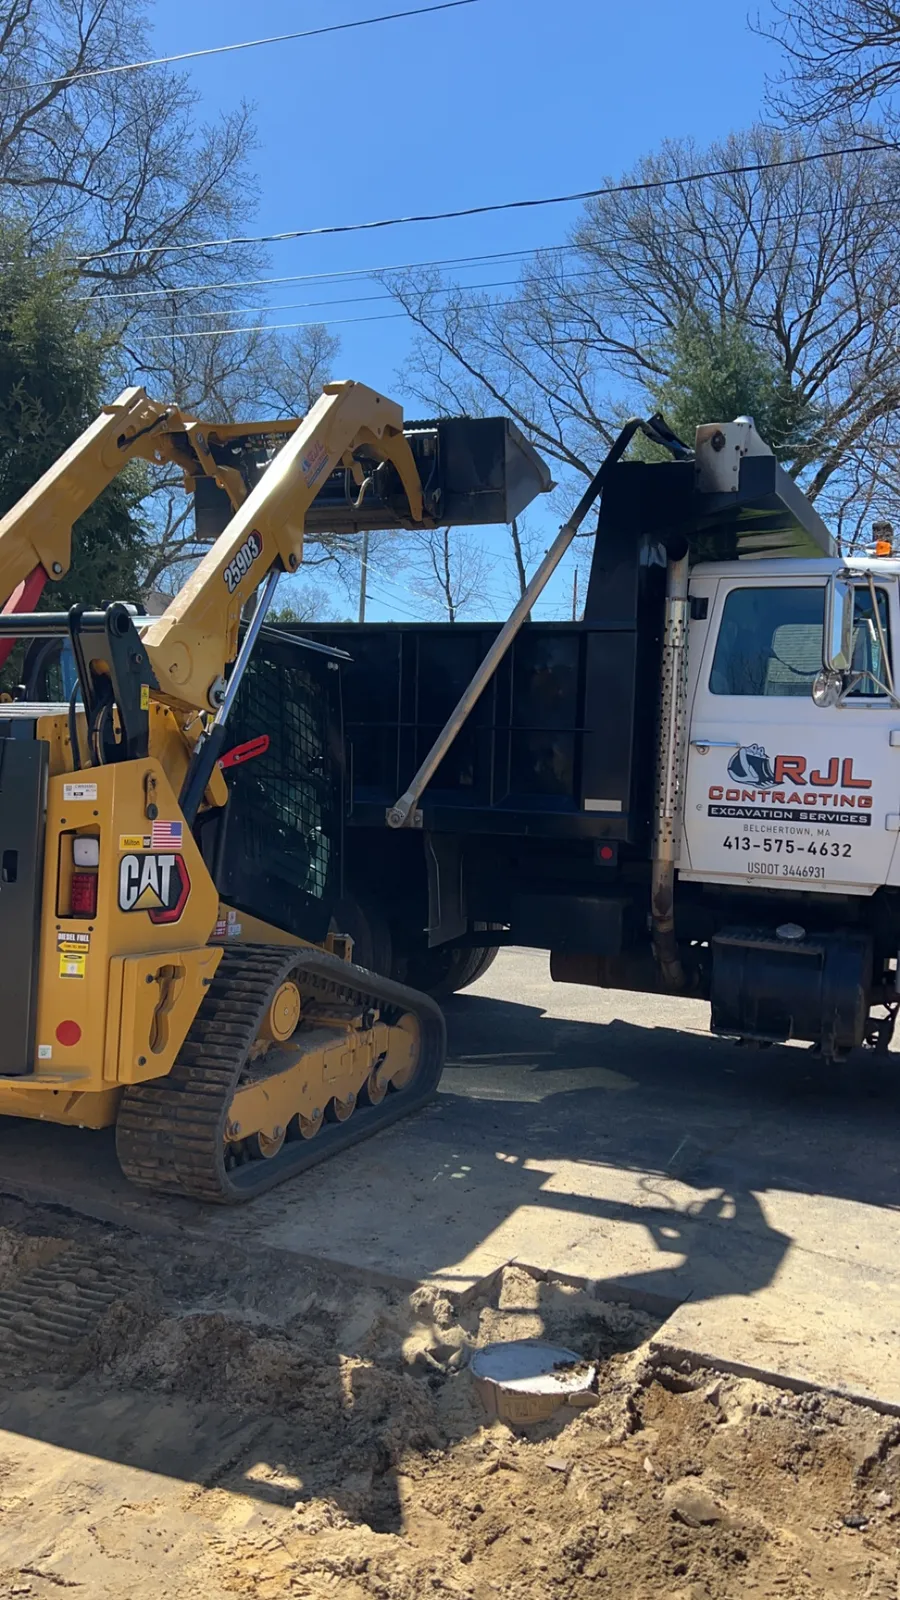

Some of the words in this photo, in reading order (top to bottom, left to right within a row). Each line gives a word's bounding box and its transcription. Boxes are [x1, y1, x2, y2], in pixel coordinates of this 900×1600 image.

[223, 535, 259, 593] 259D3
[774, 755, 873, 789] RJL
[708, 785, 873, 808] CONTRACTING
[711, 807, 794, 819] EXCAVATION
[799, 812, 868, 823] SERVICES
[743, 824, 813, 836] BELCHERTOWN,
[723, 836, 852, 858] 413-575-4632
[747, 862, 780, 875] USDOT
[782, 865, 825, 878] 3446931
[120, 855, 175, 910] CAT
[58, 932, 76, 941] DIESEL
[76, 934, 90, 942] FUEL
